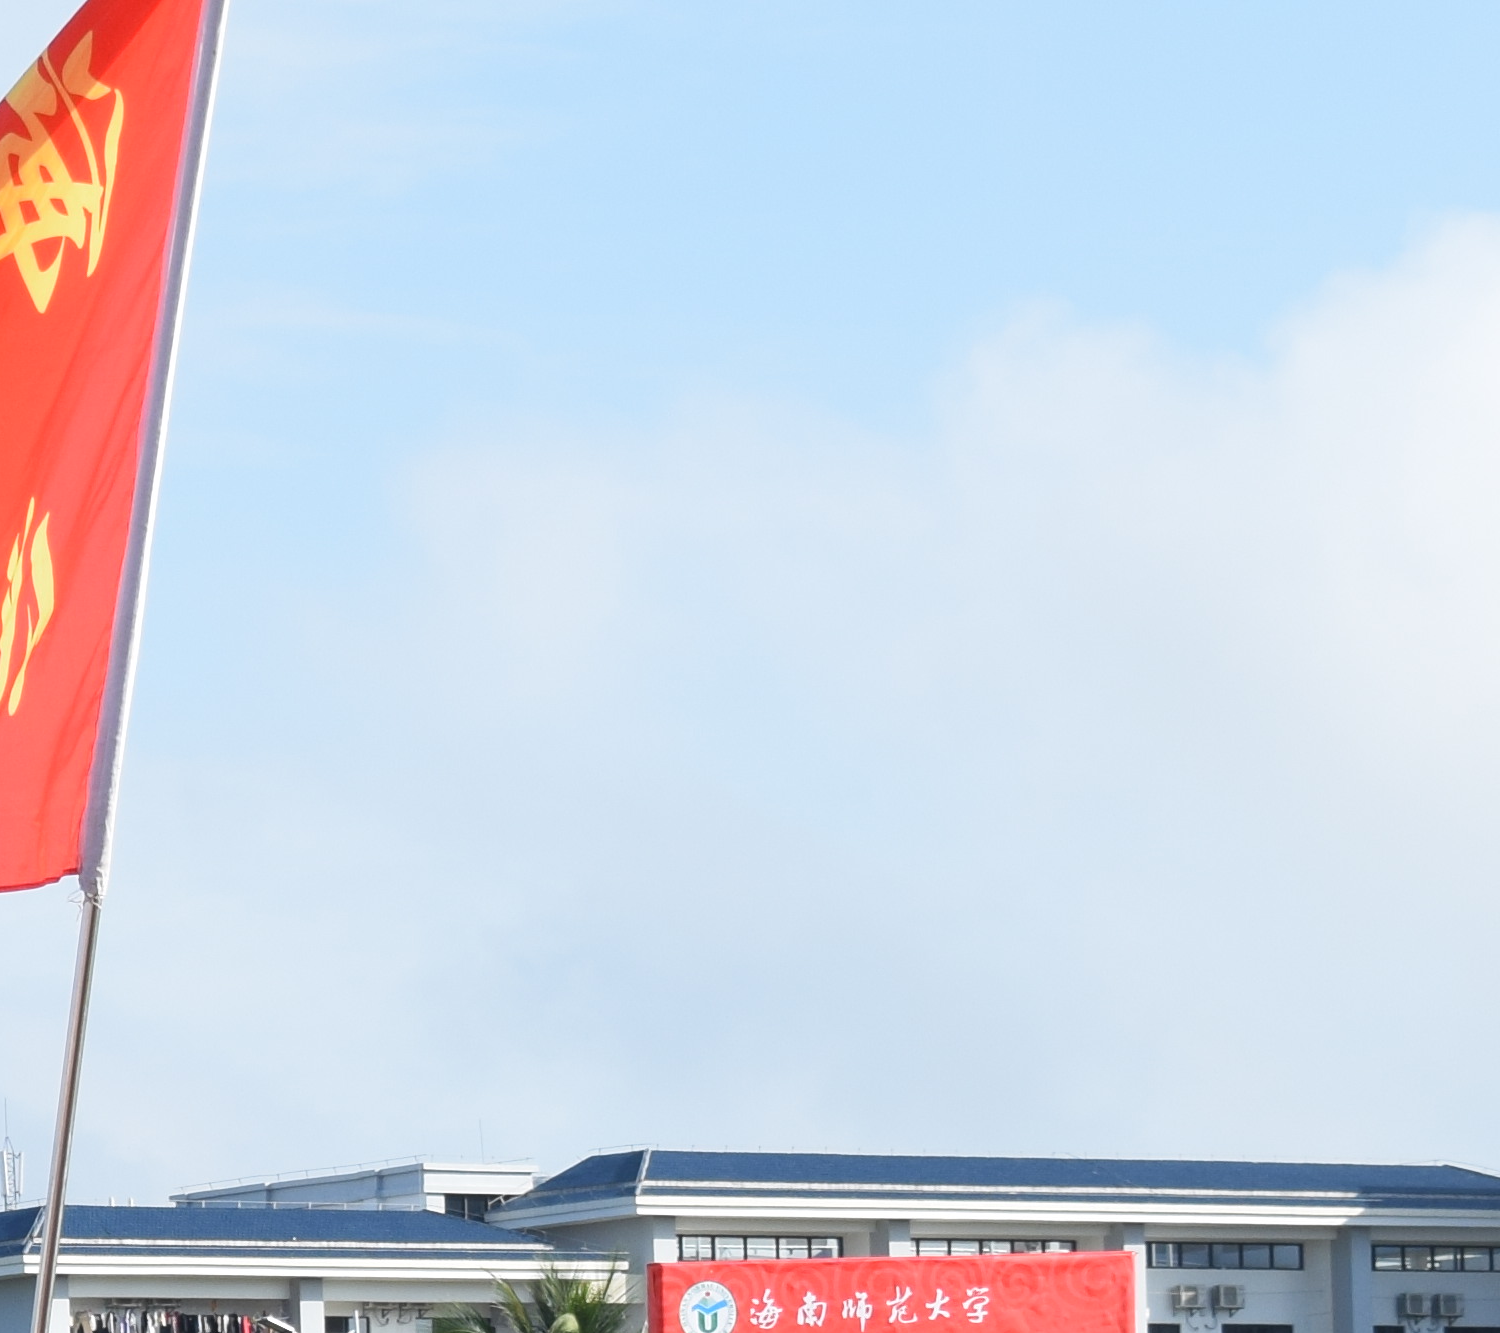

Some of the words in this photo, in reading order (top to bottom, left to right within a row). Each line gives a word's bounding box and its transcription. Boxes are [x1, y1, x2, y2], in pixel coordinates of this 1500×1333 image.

[749, 1287, 991, 1332] 海南师范大学
